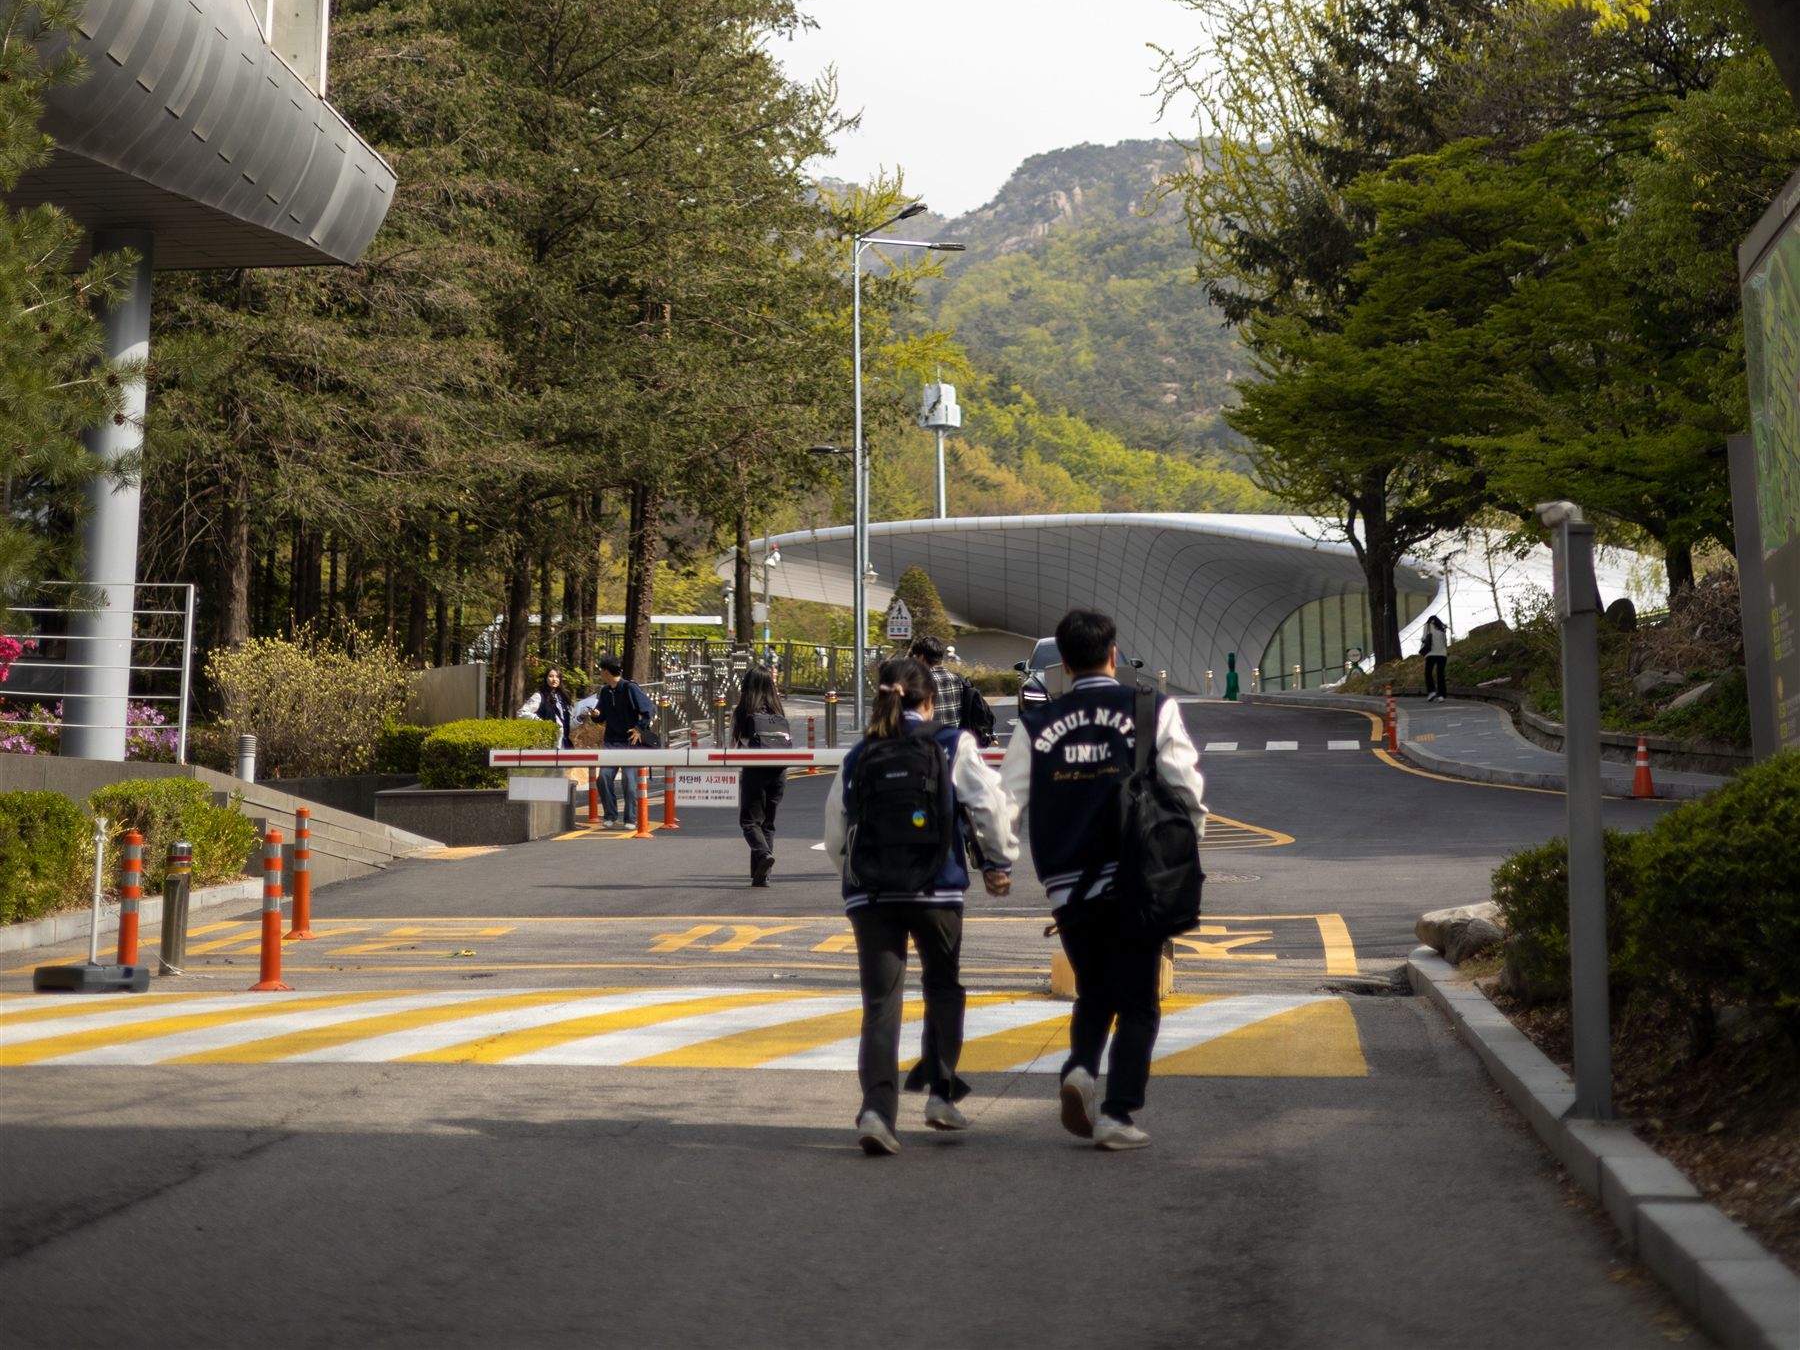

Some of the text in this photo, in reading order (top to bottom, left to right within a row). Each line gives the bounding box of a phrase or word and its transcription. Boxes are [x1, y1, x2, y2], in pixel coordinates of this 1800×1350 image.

[1034, 710, 1090, 754] SEOUL
[1064, 742, 1112, 763] UNIV.
[678, 775, 702, 784] 차단바
